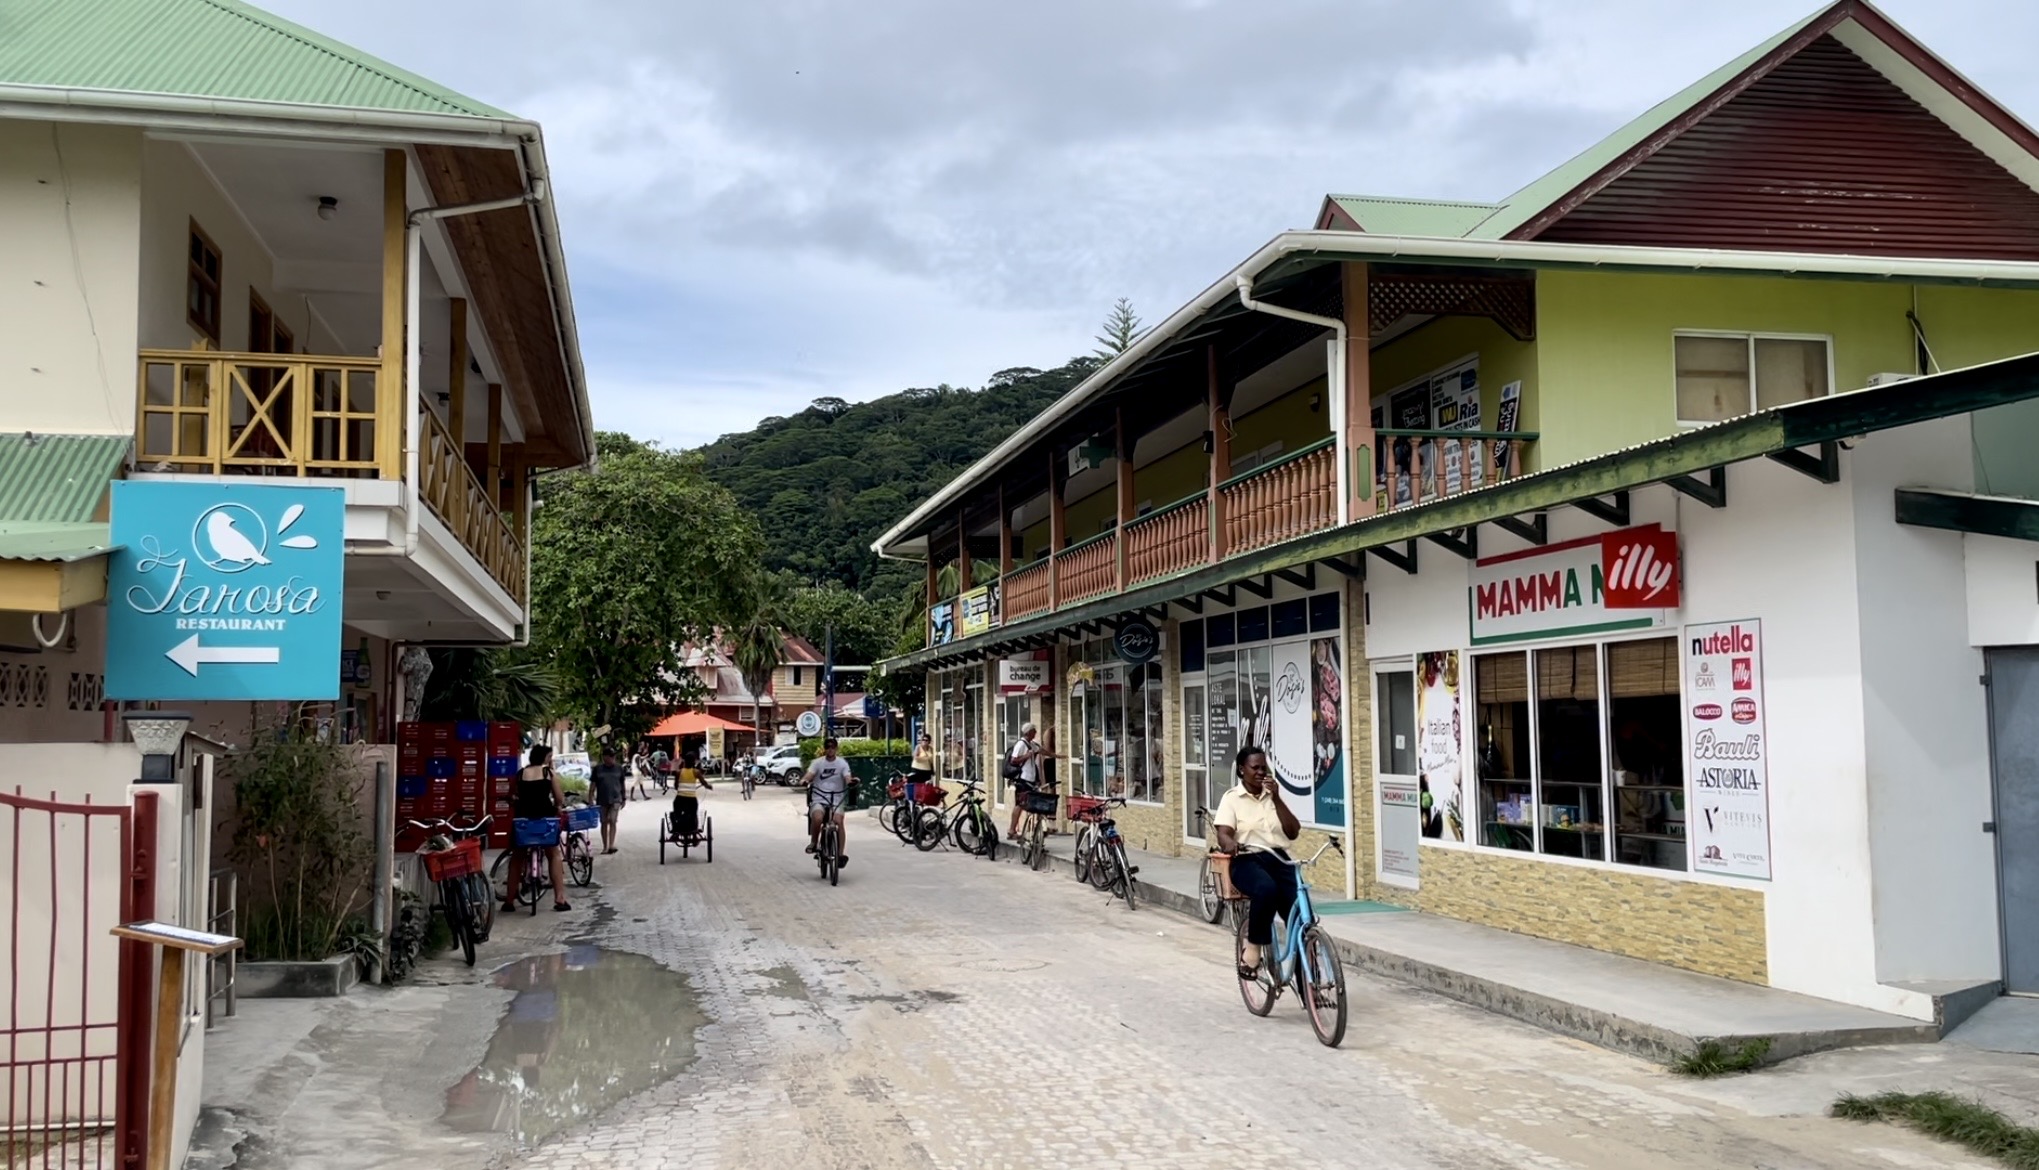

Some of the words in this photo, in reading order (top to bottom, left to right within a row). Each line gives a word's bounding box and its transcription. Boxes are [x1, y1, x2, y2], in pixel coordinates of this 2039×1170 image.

[1460, 395, 1478, 421] Ria
[1608, 542, 1673, 601] illy
[1476, 567, 1582, 621] MAMMA
[175, 618, 286, 631] RESTAURANT
[1692, 625, 1753, 656] nutella
[1009, 672, 1041, 683] change
[1733, 662, 1751, 687] illy
[1428, 718, 1451, 736] Italian
[1431, 737, 1448, 755] food
[1694, 727, 1760, 761] Bauli
[1696, 767, 1762, 791] ASTORIA
